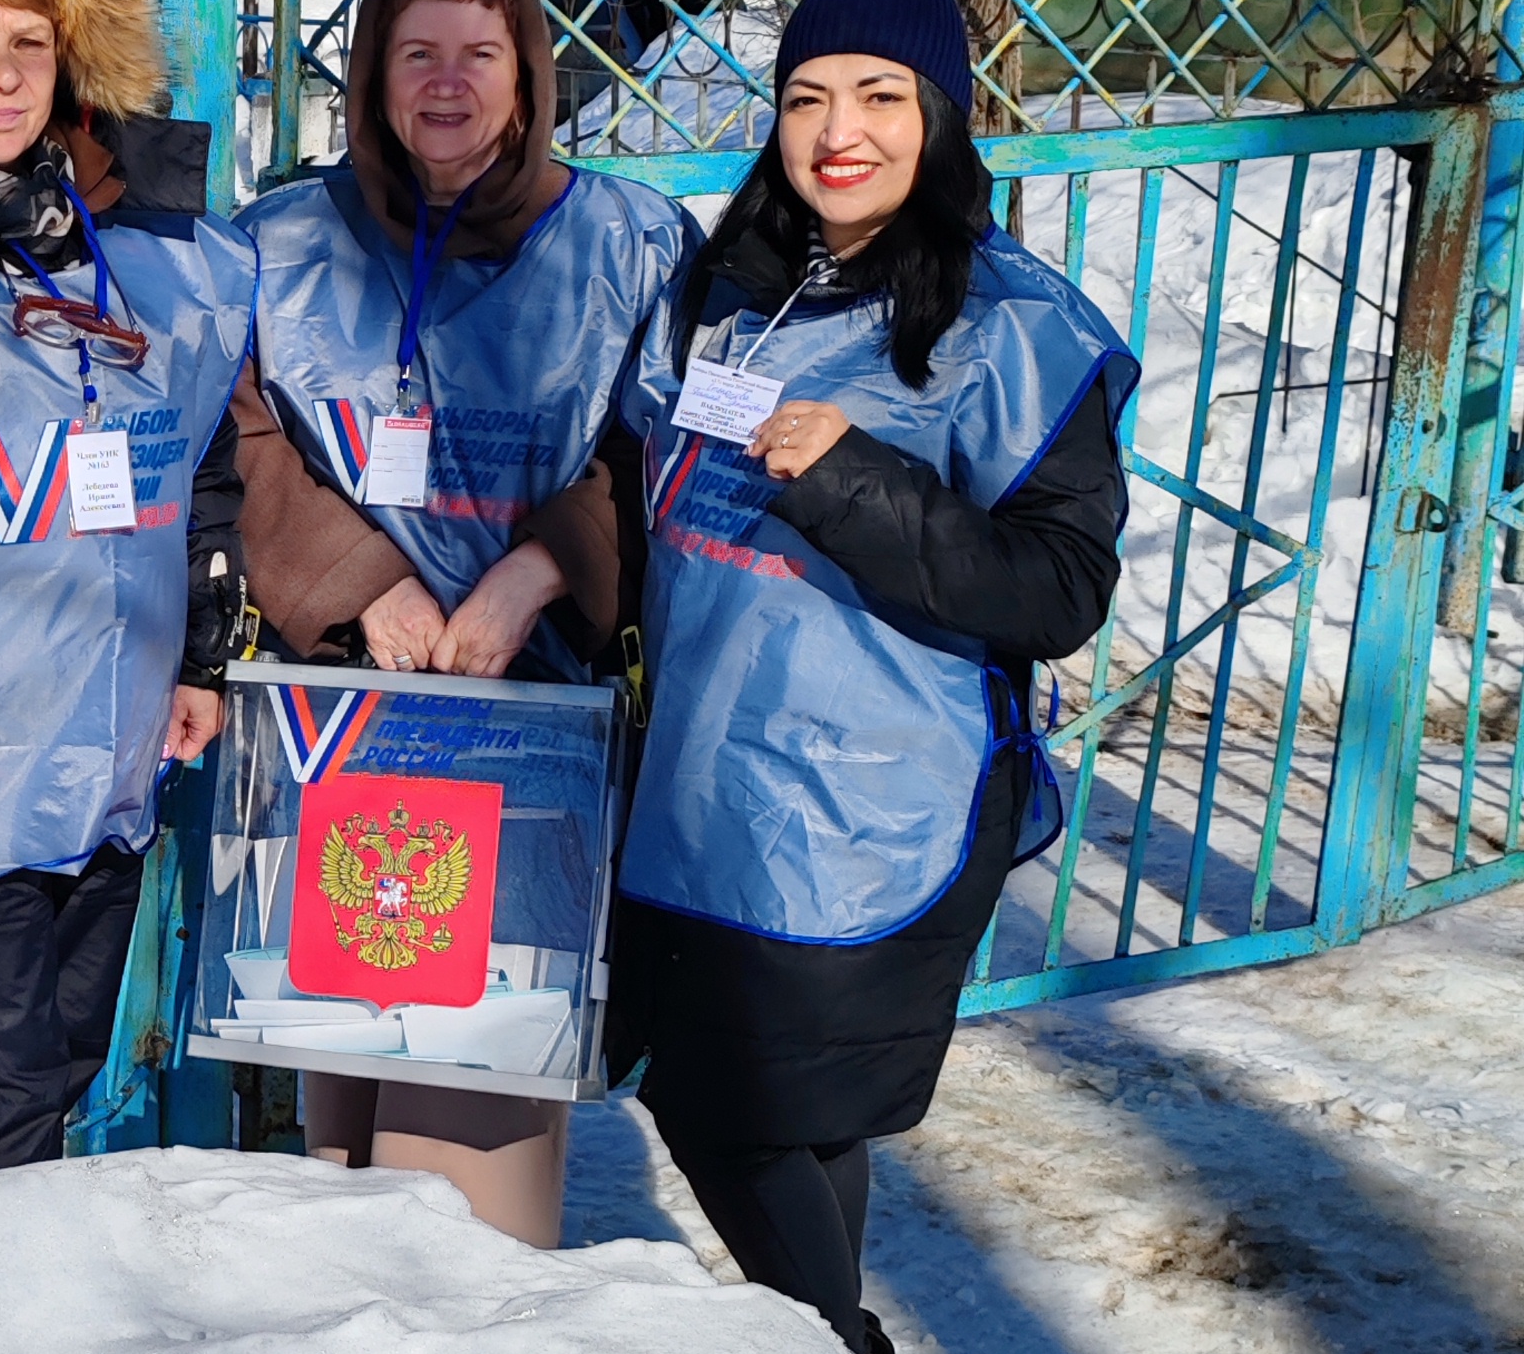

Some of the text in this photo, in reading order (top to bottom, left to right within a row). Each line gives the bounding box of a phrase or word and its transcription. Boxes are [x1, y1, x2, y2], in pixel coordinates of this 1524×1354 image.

[88, 461, 110, 470] №163
[82, 483, 119, 491] Лебедева
[675, 498, 762, 541] РОССИИ
[390, 694, 494, 719] ВЫБОРЫ
[376, 719, 522, 750] ПРЕЗИДЕНТА
[361, 745, 457, 771] РОССИИ
